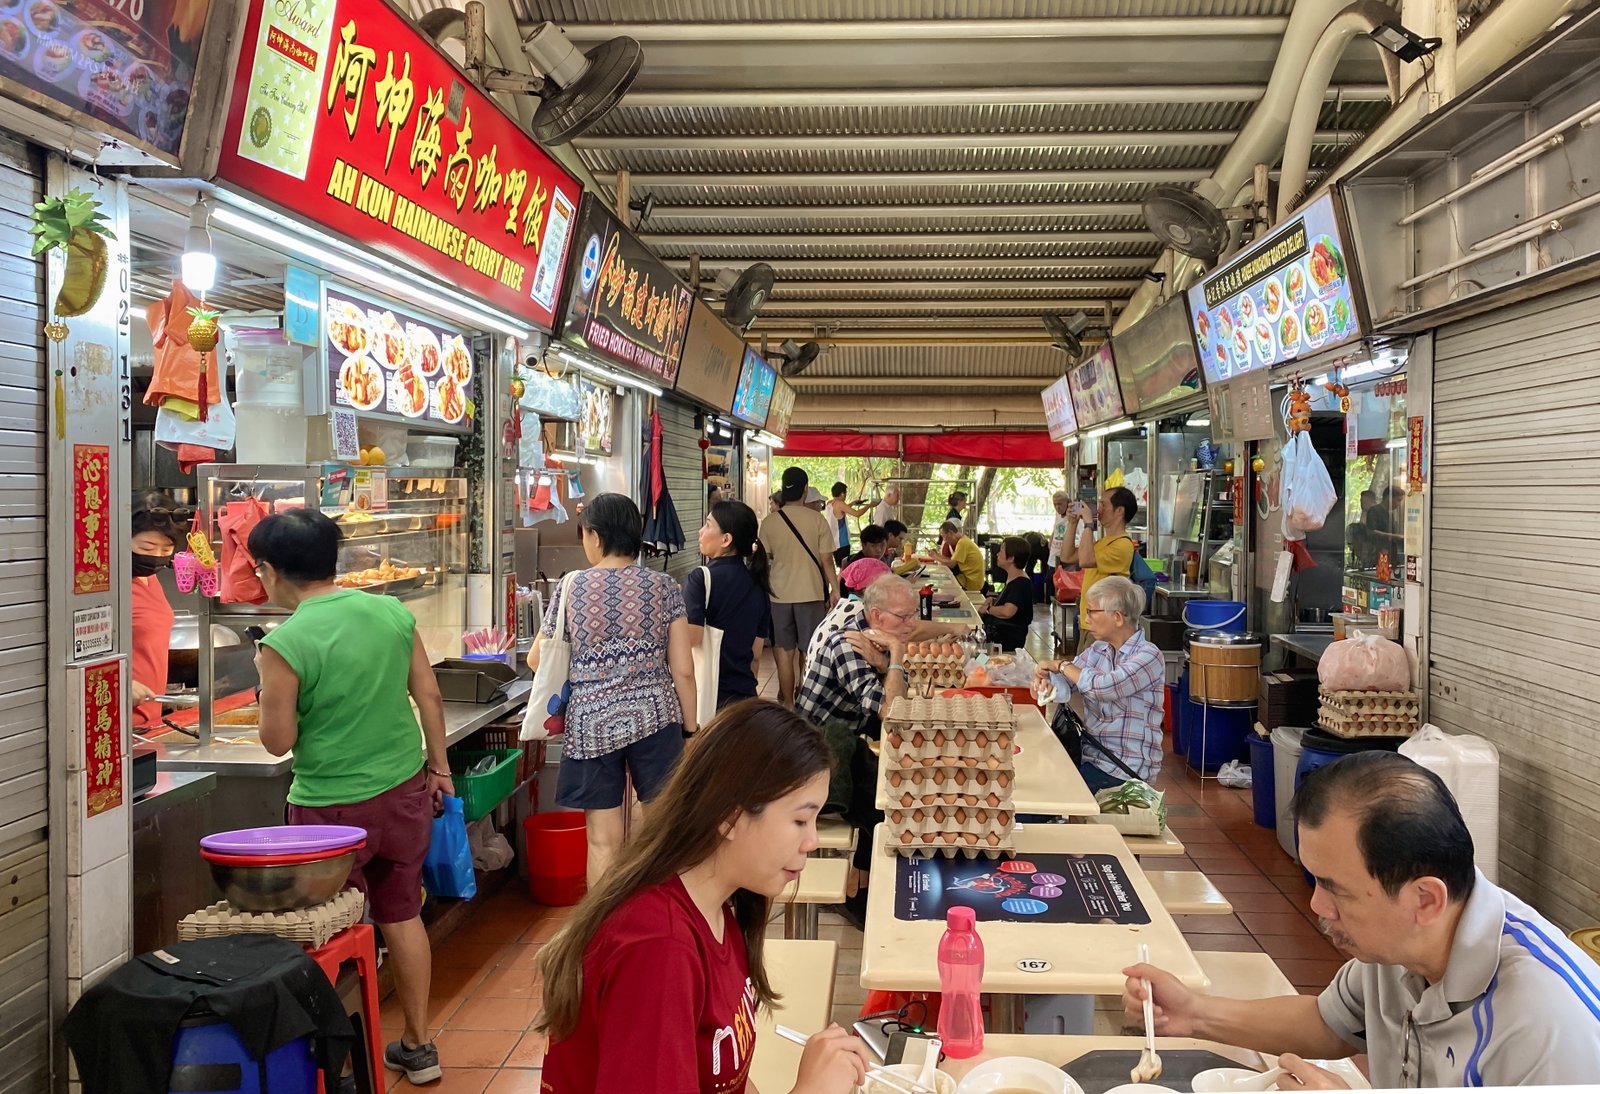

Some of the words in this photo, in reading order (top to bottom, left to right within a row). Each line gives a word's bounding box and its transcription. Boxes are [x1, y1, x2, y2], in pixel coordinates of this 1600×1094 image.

[275, 0, 324, 39] Award
[326, 158, 359, 206] AH
[356, 171, 395, 224] KUN
[392, 190, 468, 260] HAINANESE
[464, 233, 504, 280] CURRY
[500, 254, 525, 292] RICE
[51, 327, 64, 340] 福
[117, 252, 132, 443] #02-131
[587, 320, 610, 348] FRIED
[607, 331, 636, 360] HOKKIEN
[633, 344, 654, 369] PRAWN
[652, 353, 664, 373] MEE
[82, 458, 102, 568] 心想事成
[94, 679, 113, 786] 龍馬精神
[1110, 883, 1129, 903] Healthier
[1020, 961, 1047, 970] 167
